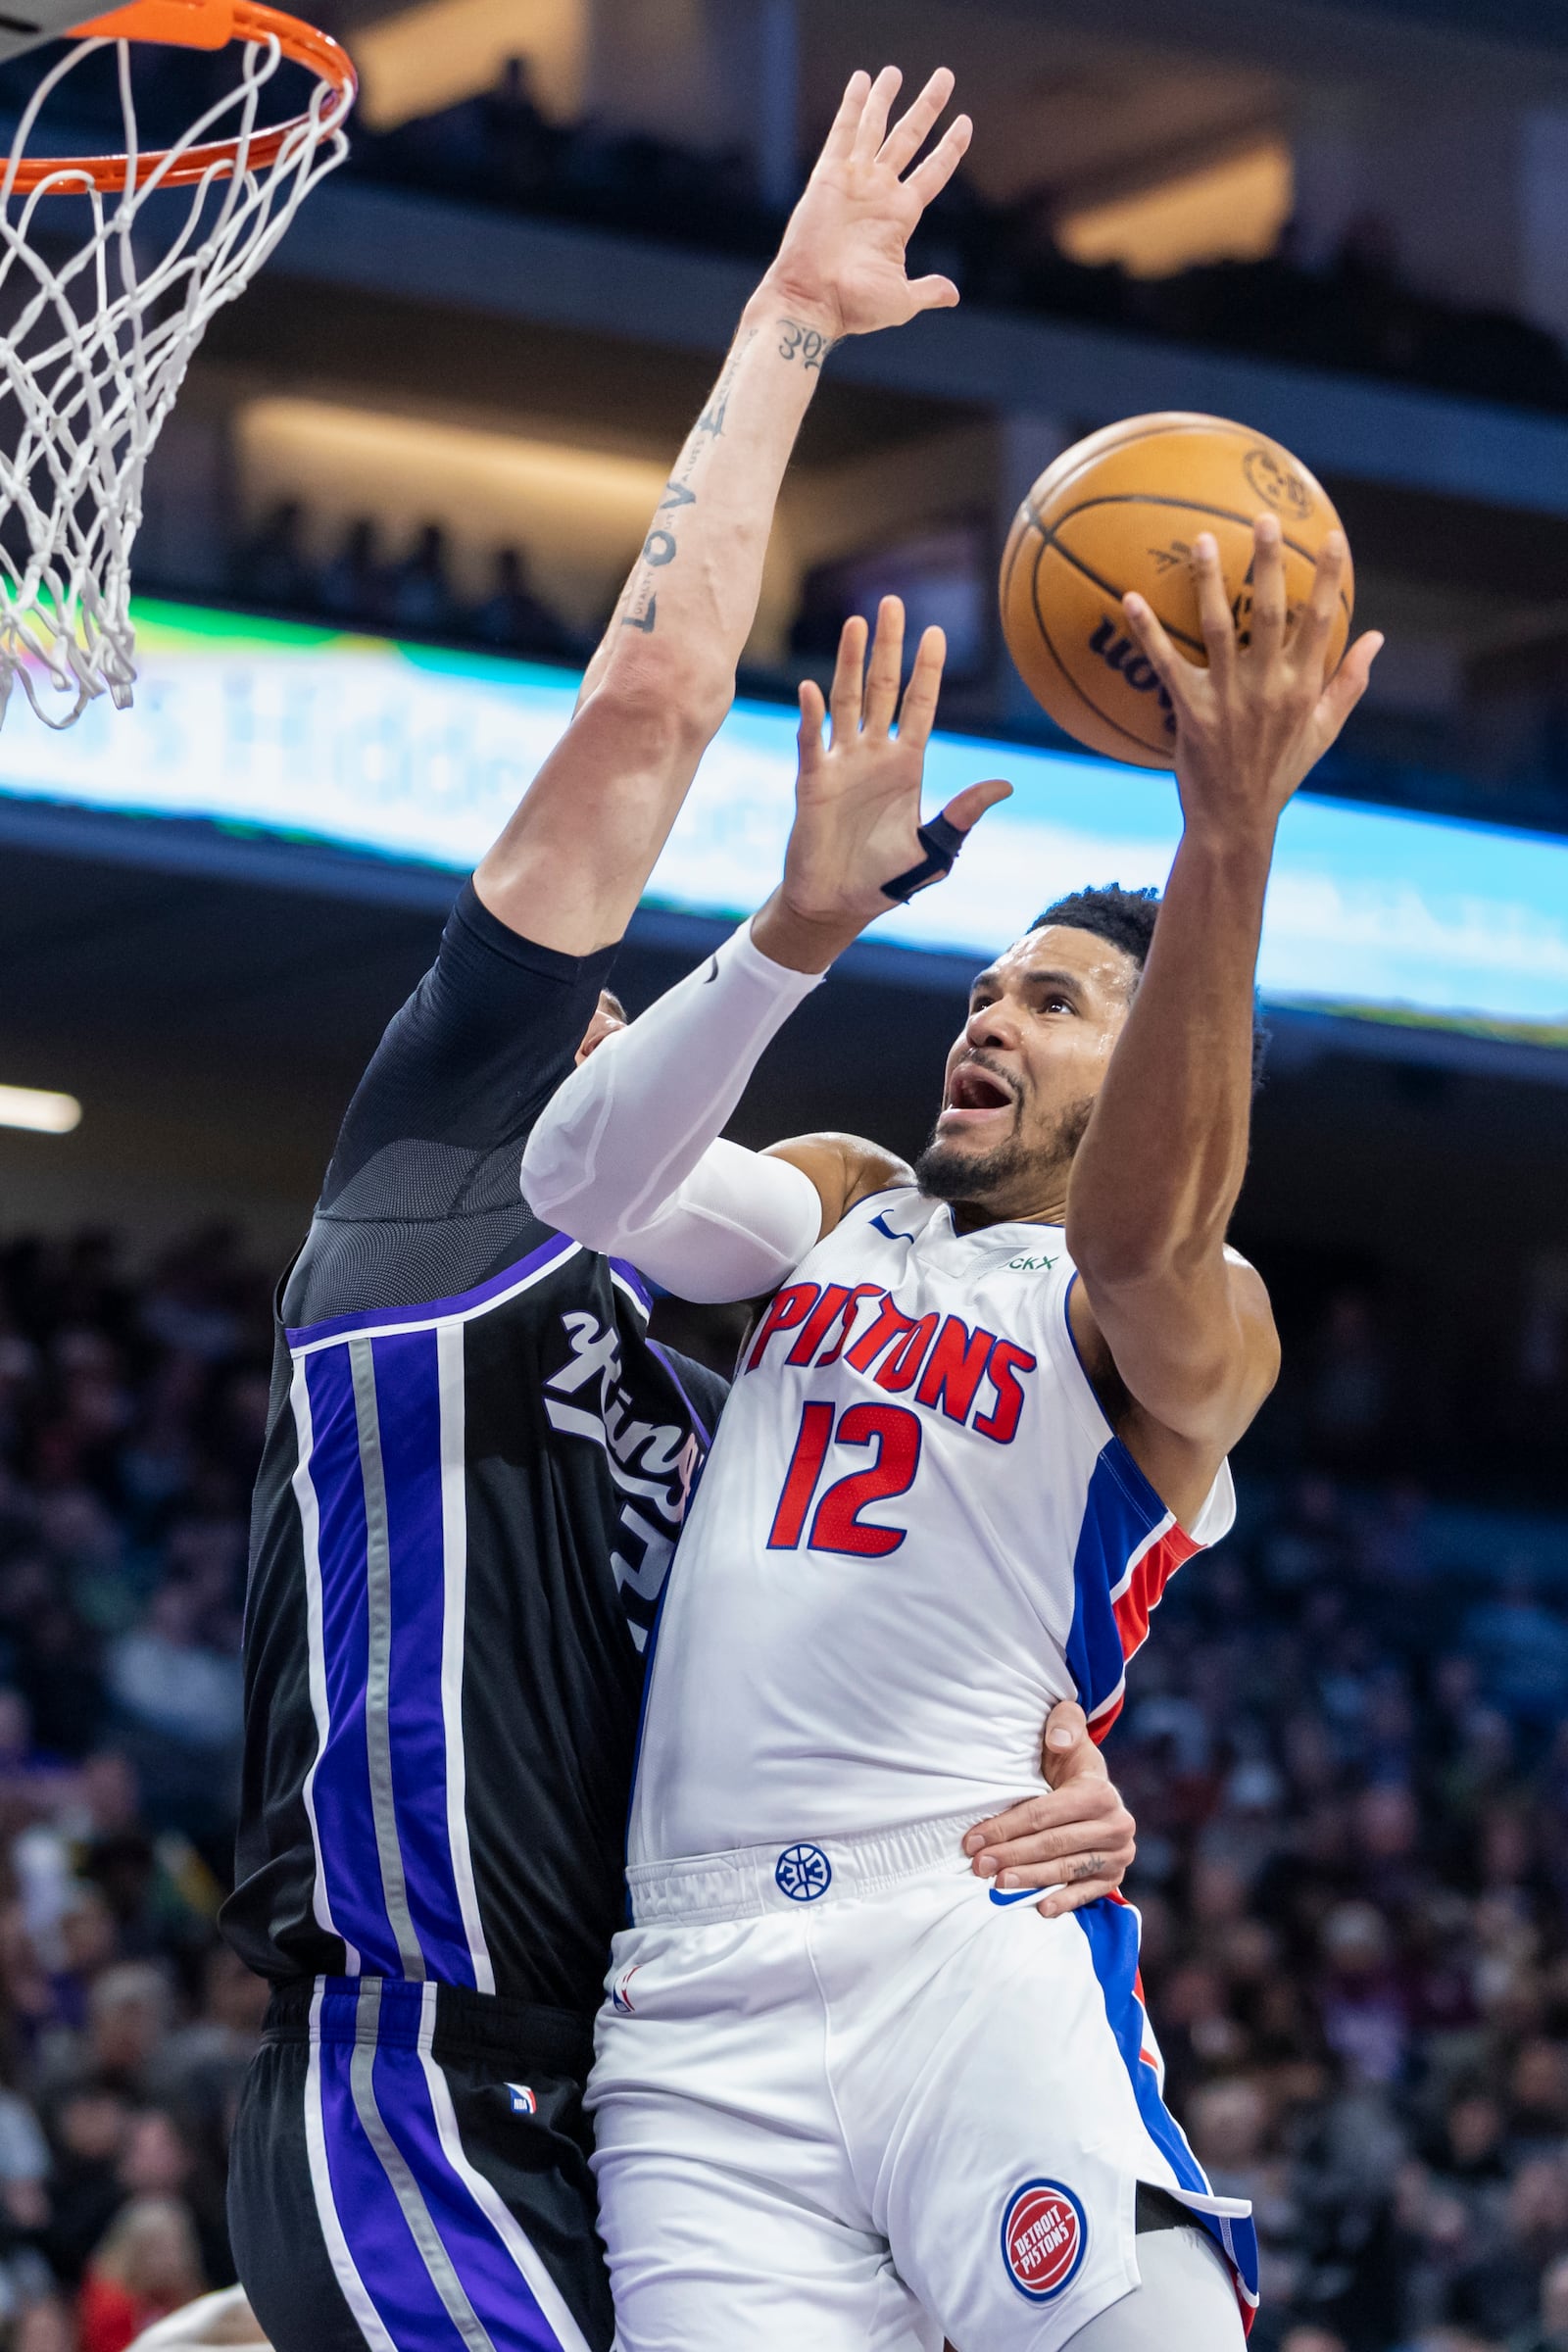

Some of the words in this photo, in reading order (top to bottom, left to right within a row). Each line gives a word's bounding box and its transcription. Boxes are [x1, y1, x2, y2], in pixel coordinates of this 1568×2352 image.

[542, 1310, 706, 1524] King
[744, 1282, 1038, 1445] PISTONS
[765, 1401, 922, 1558] 12
[1013, 2204, 1062, 2259] DETROIT
[1020, 2221, 1071, 2276] PISTONS
